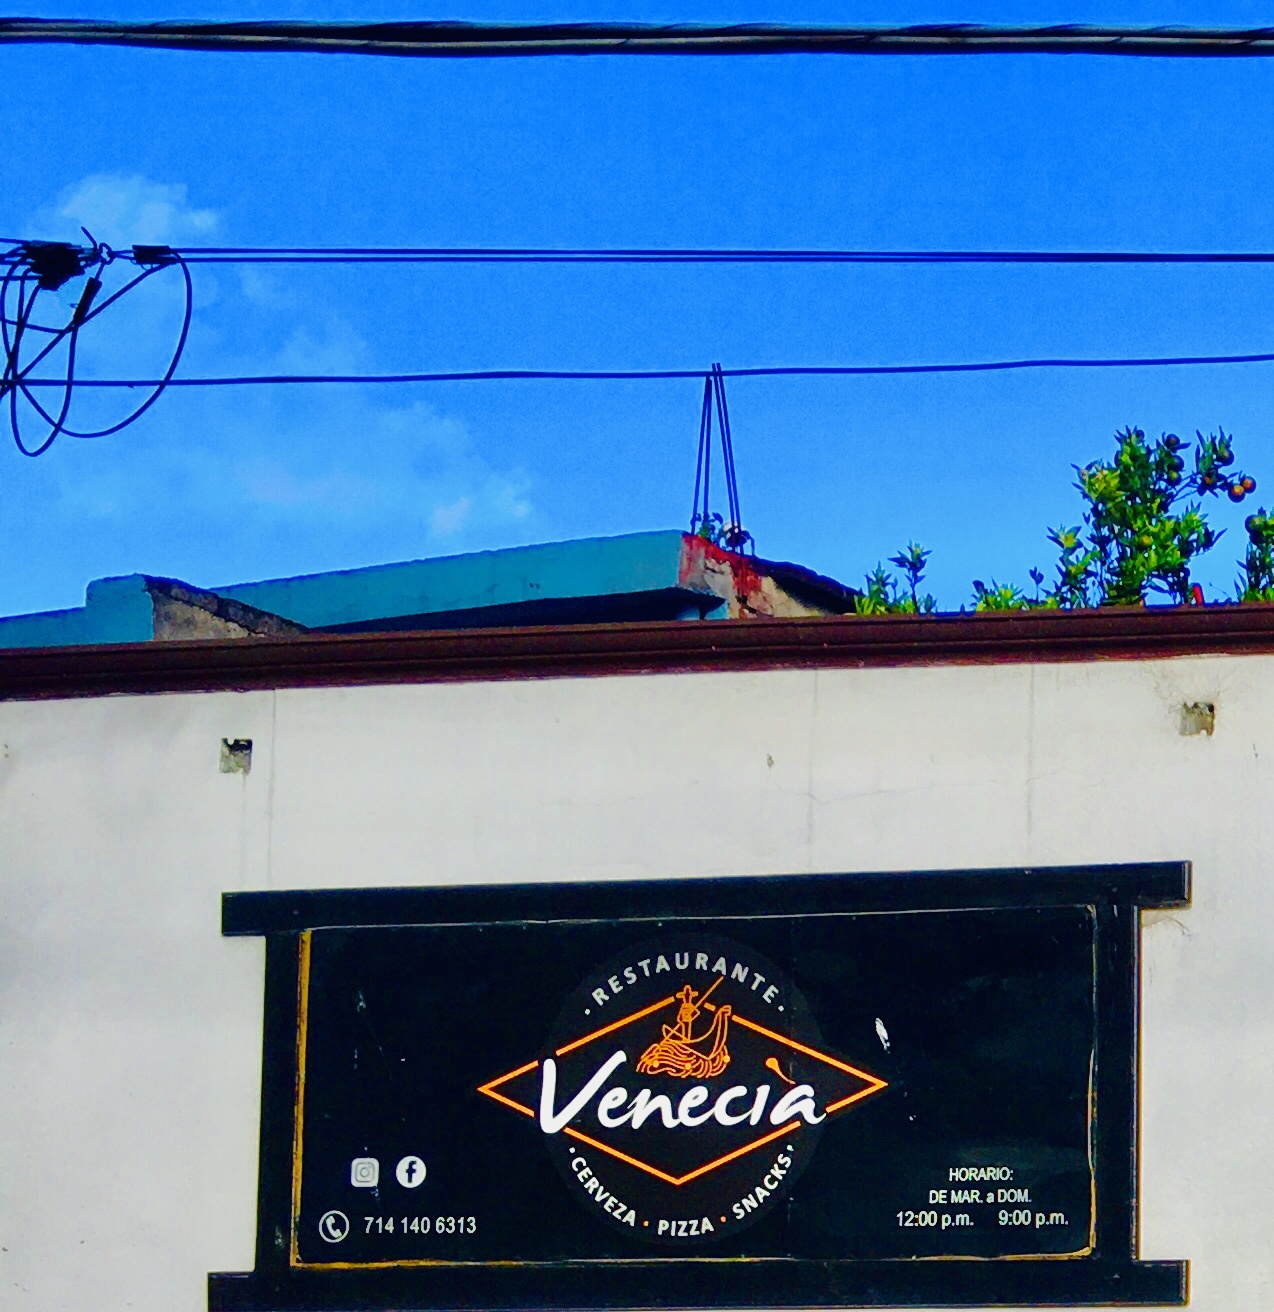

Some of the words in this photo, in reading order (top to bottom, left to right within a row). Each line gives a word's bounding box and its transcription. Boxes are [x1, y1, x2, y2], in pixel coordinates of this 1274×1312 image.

[592, 952, 778, 1006] RESTAURANTE
[949, 1166, 1013, 1182] HORARIO:
[571, 1156, 636, 1227] CERVEZA
[657, 1216, 714, 1237] PIZZA
[732, 1153, 792, 1220] SNACKS
[929, 1190, 948, 1204] DE
[951, 1190, 983, 1204] MAR.
[986, 1192, 995, 1204] a
[997, 1189, 1032, 1203] DOM.
[364, 1216, 395, 1234] 714
[401, 1216, 431, 1234] 140
[435, 1216, 477, 1234] 6313
[896, 1210, 938, 1227] 12:00
[942, 1212, 974, 1230] p.m.
[998, 1209, 1032, 1226] 9:00
[1035, 1211, 1069, 1229] p.m.
